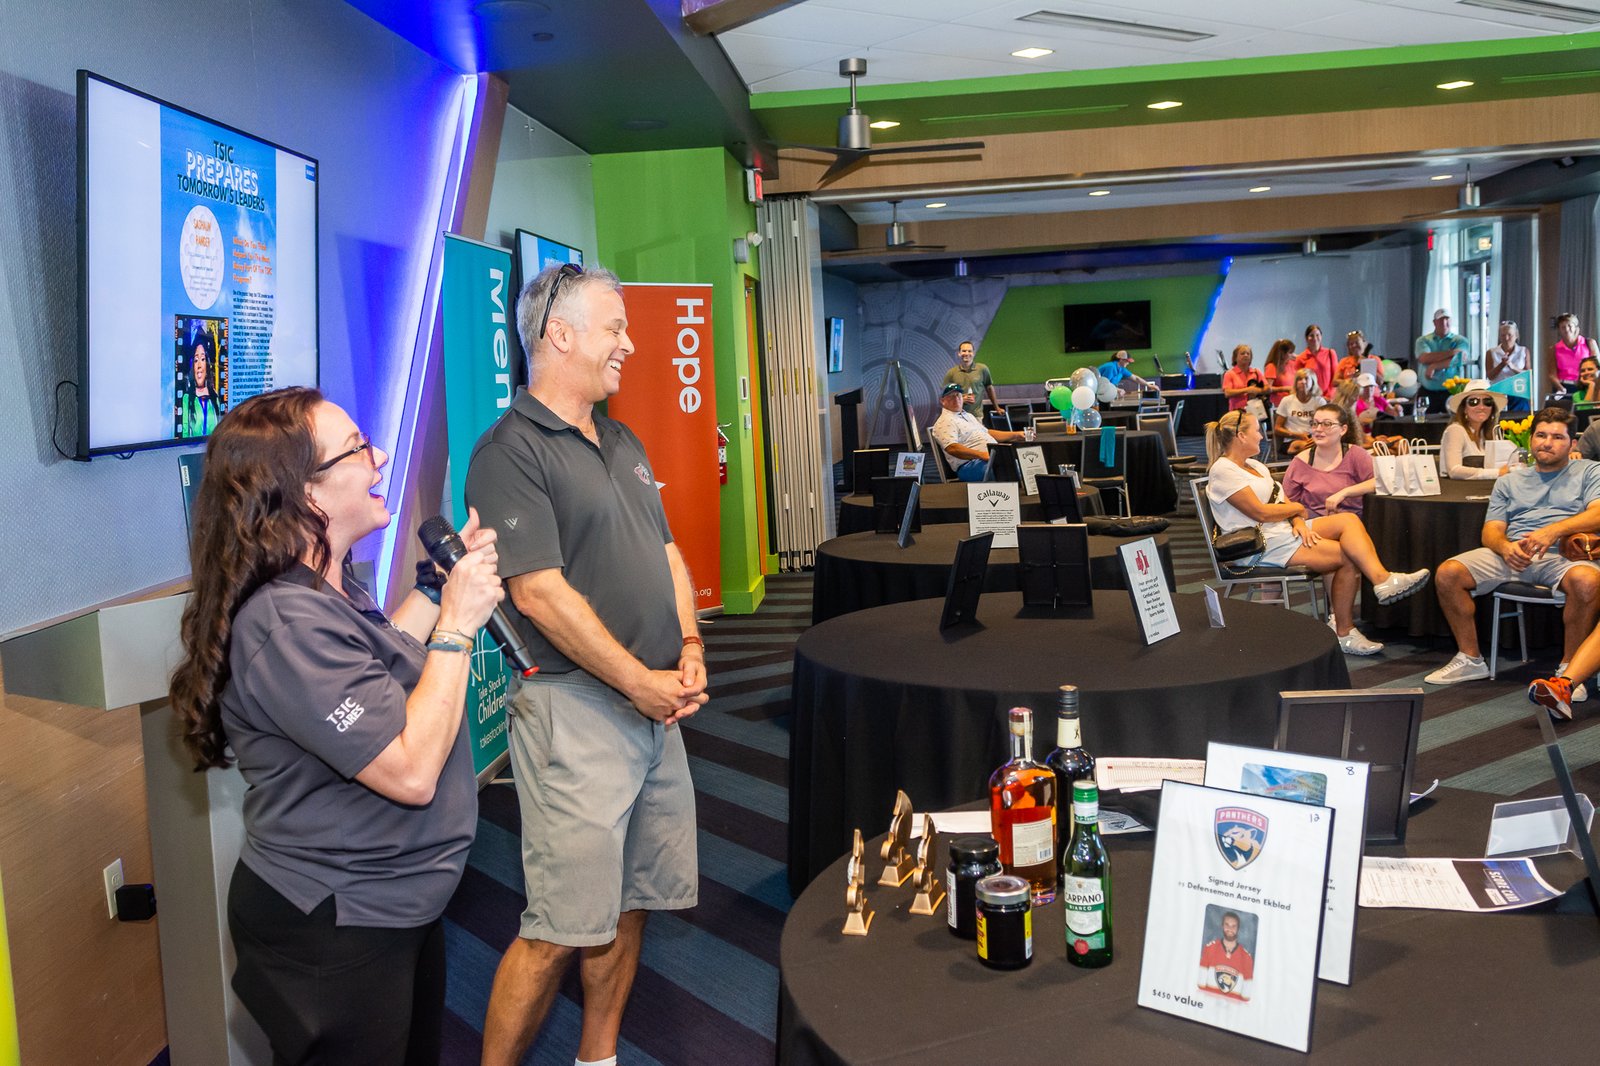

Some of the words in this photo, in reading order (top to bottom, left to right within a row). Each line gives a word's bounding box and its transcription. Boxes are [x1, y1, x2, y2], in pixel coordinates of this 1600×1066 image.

[213, 140, 234, 163] TSIC
[186, 148, 259, 196] PREPARES
[177, 174, 234, 204] TOMORROW'S
[235, 191, 265, 212] LEADERS
[490, 268, 511, 419] Men
[672, 298, 704, 413] Hope
[977, 489, 1010, 501] Callaway
[478, 684, 488, 700] Take
[488, 674, 501, 693] Stock
[501, 672, 507, 685] in
[325, 696, 357, 724] TSIC
[336, 704, 365, 732] CARES
[478, 691, 507, 724] Children
[1345, 766, 1355, 776] 8
[1219, 811, 1264, 827] PANTHERS
[1187, 882, 1235, 898] Defenseman
[1236, 893, 1261, 904] Aaron
[1263, 898, 1291, 911] Ekblad
[1208, 875, 1234, 888] Signed
[1236, 882, 1262, 895] Jersey
[1152, 989, 1171, 999] $450
[1174, 995, 1203, 1008] value
